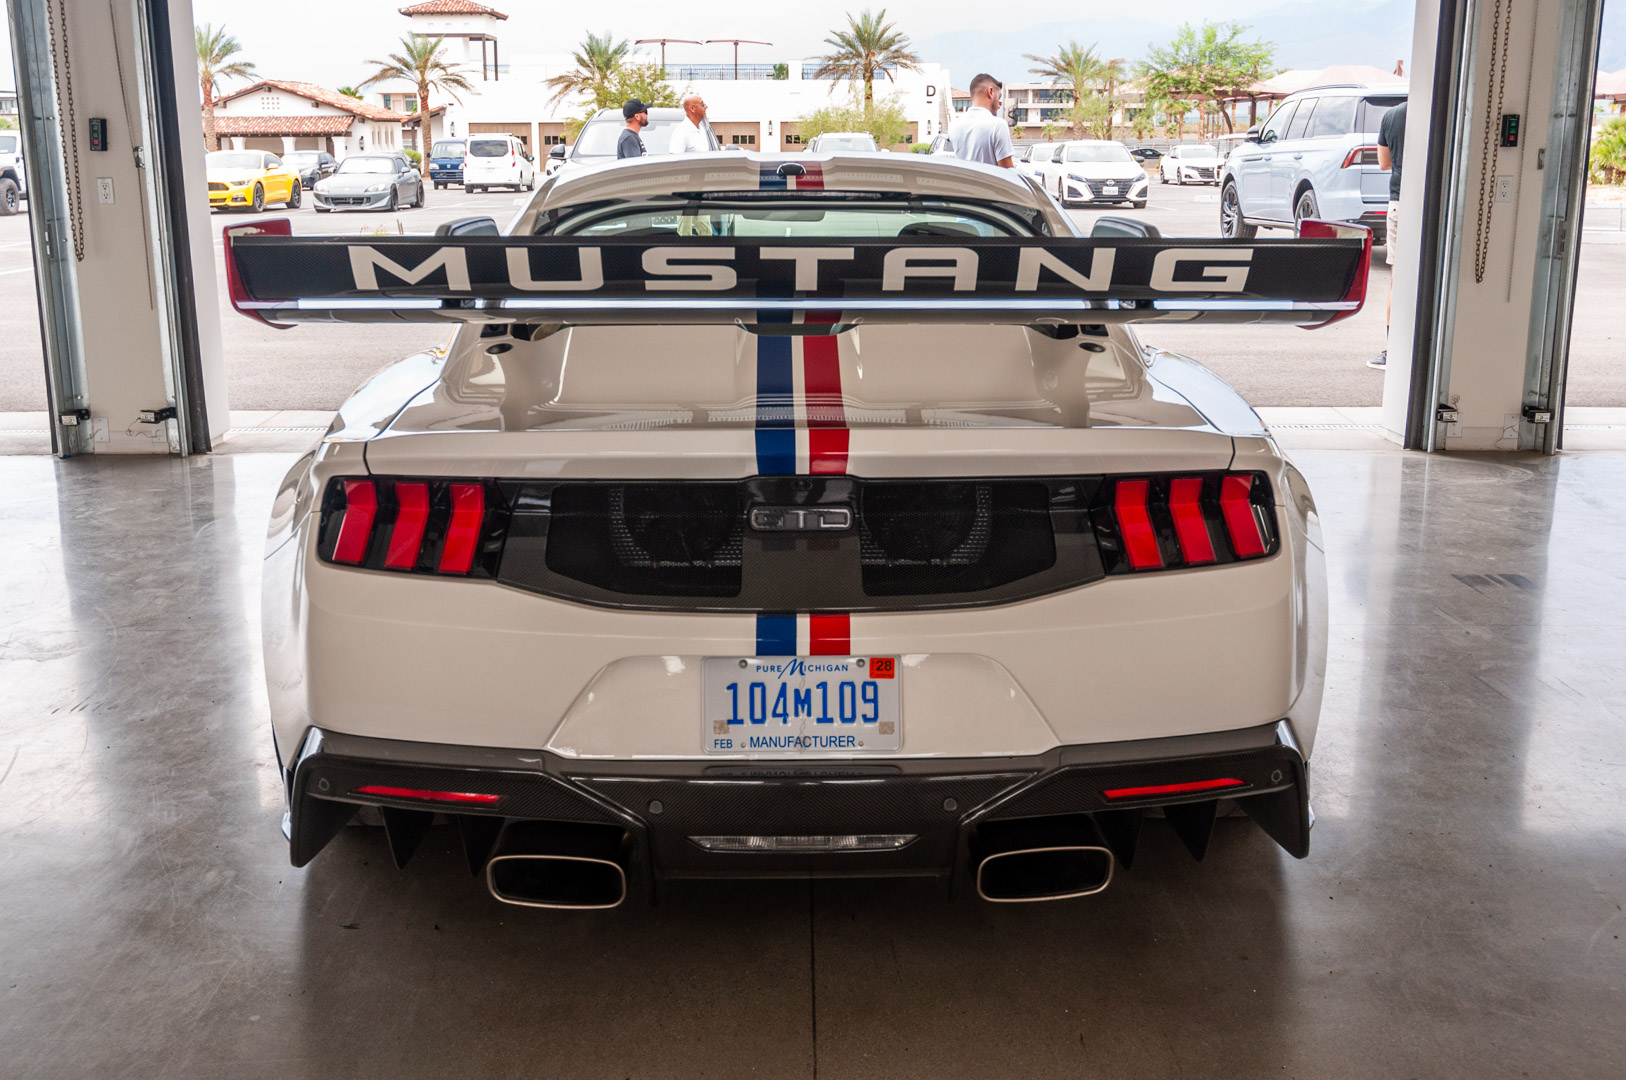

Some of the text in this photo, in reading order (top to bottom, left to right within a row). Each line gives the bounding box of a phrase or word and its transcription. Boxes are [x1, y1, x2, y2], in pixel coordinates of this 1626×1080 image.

[926, 85, 936, 97] D
[347, 246, 1254, 292] MUSTANG
[756, 658, 849, 680] PURE MICHIGAN
[876, 660, 892, 671] 28
[726, 681, 879, 725] 104M109
[714, 736, 855, 749] FEB MANUFACTURER
